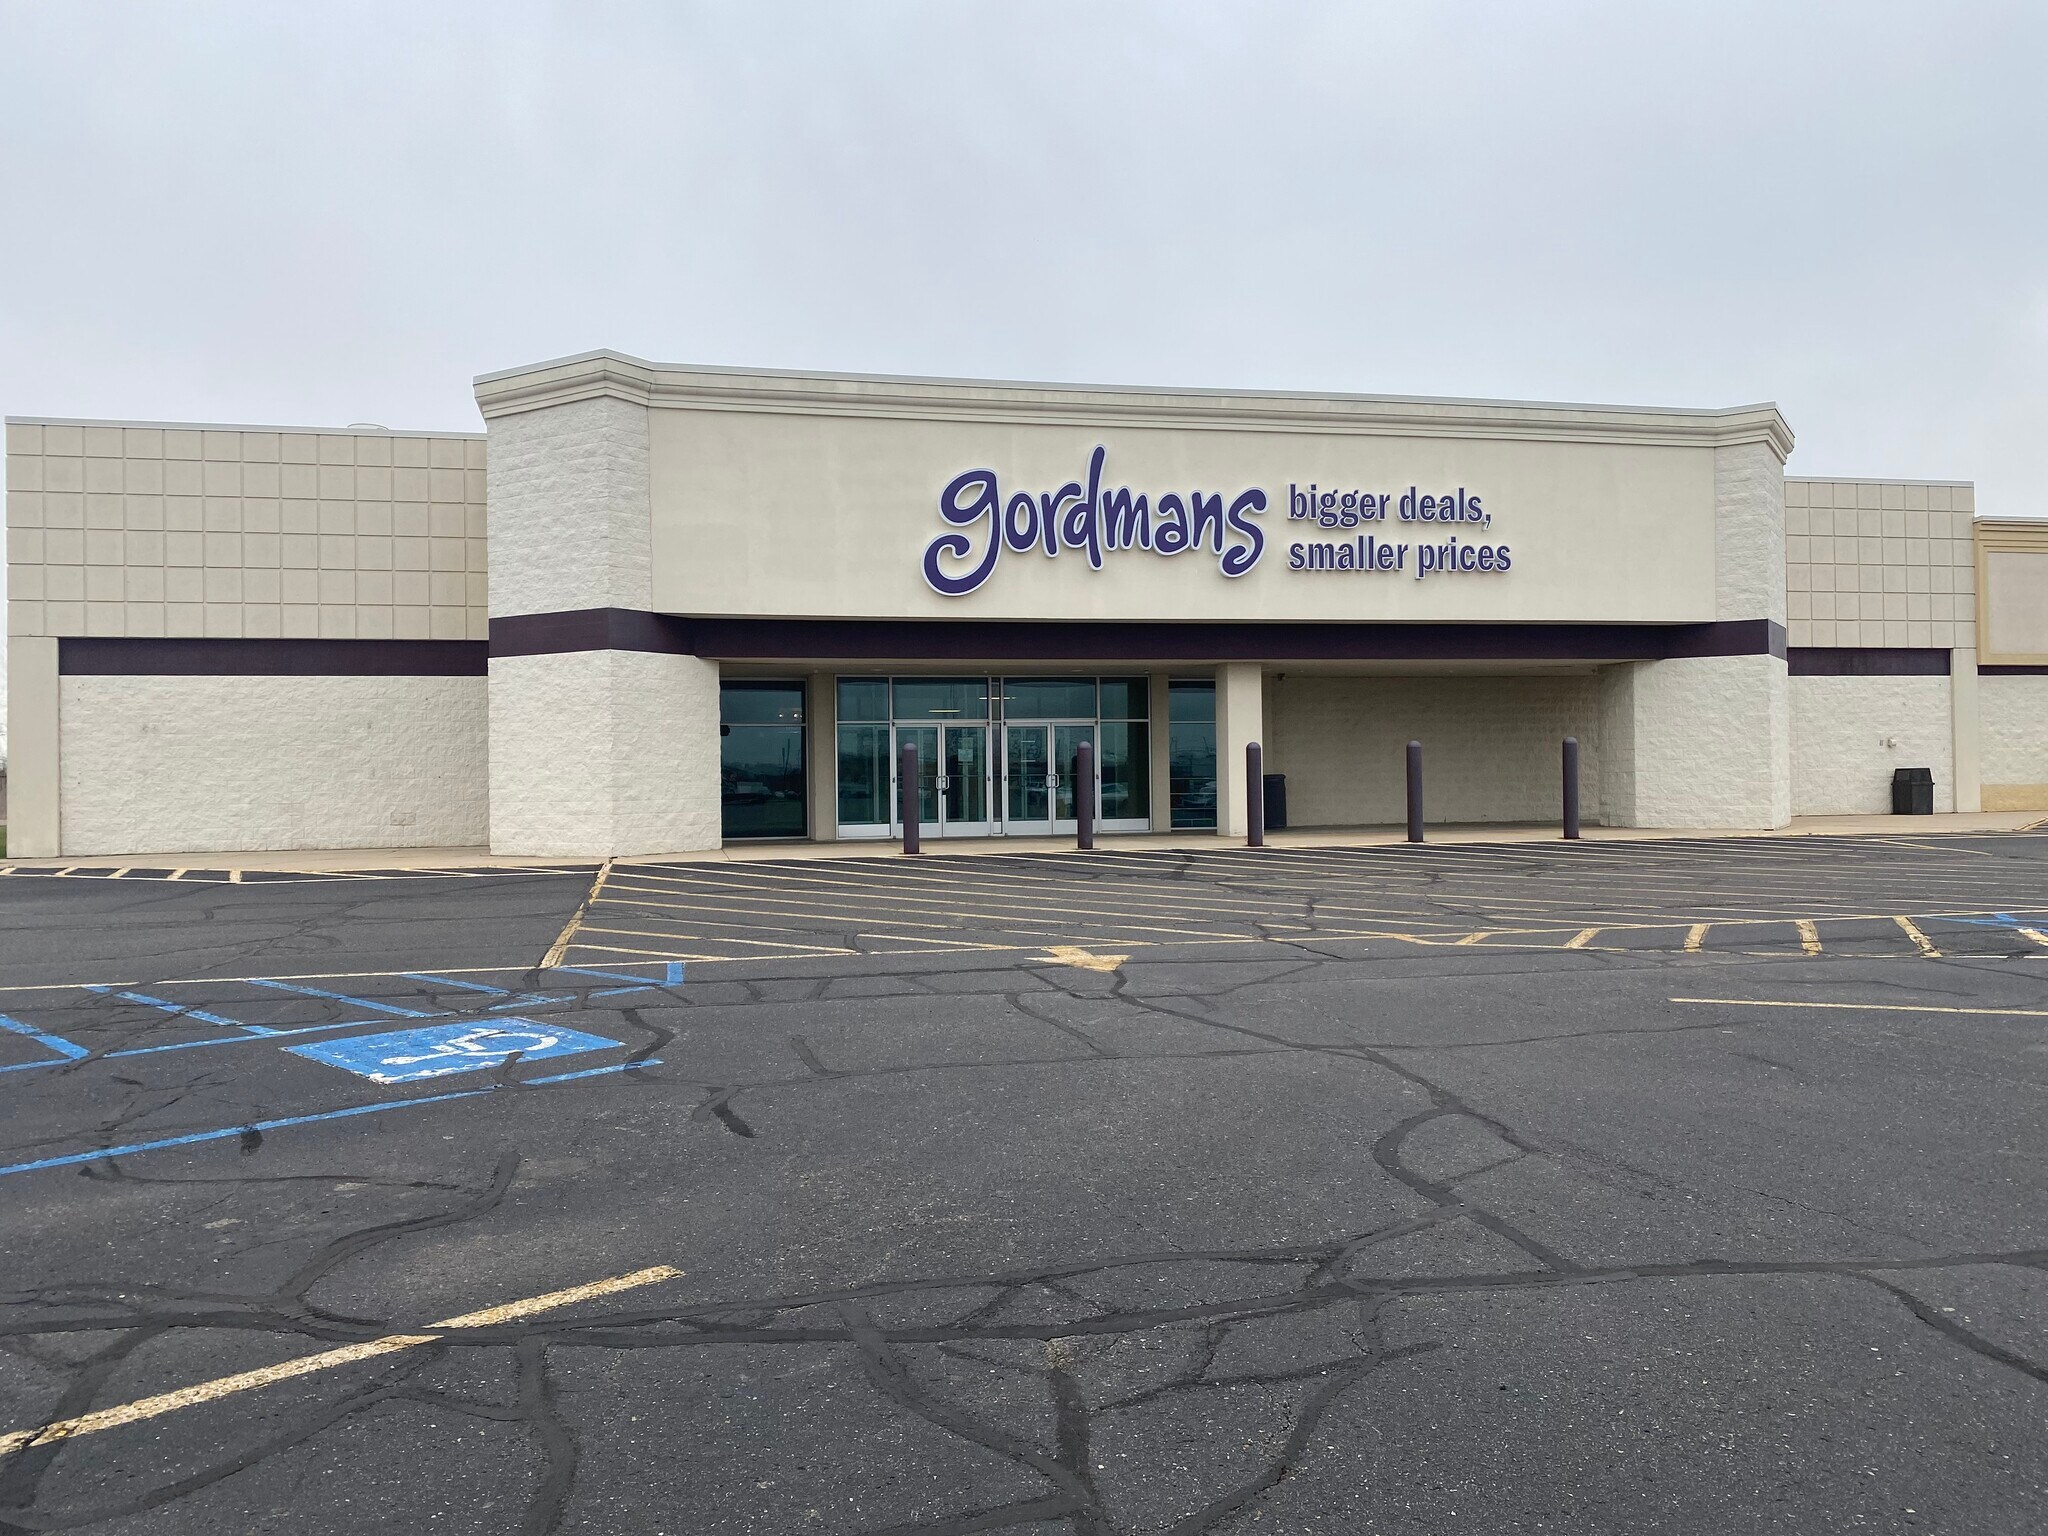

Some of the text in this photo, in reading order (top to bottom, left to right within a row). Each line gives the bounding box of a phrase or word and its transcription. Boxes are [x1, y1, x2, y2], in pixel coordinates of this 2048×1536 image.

[923, 445, 1267, 595] gordmans
[1289, 484, 1492, 529] bigger deals,
[1290, 535, 1512, 578] smaller prices
